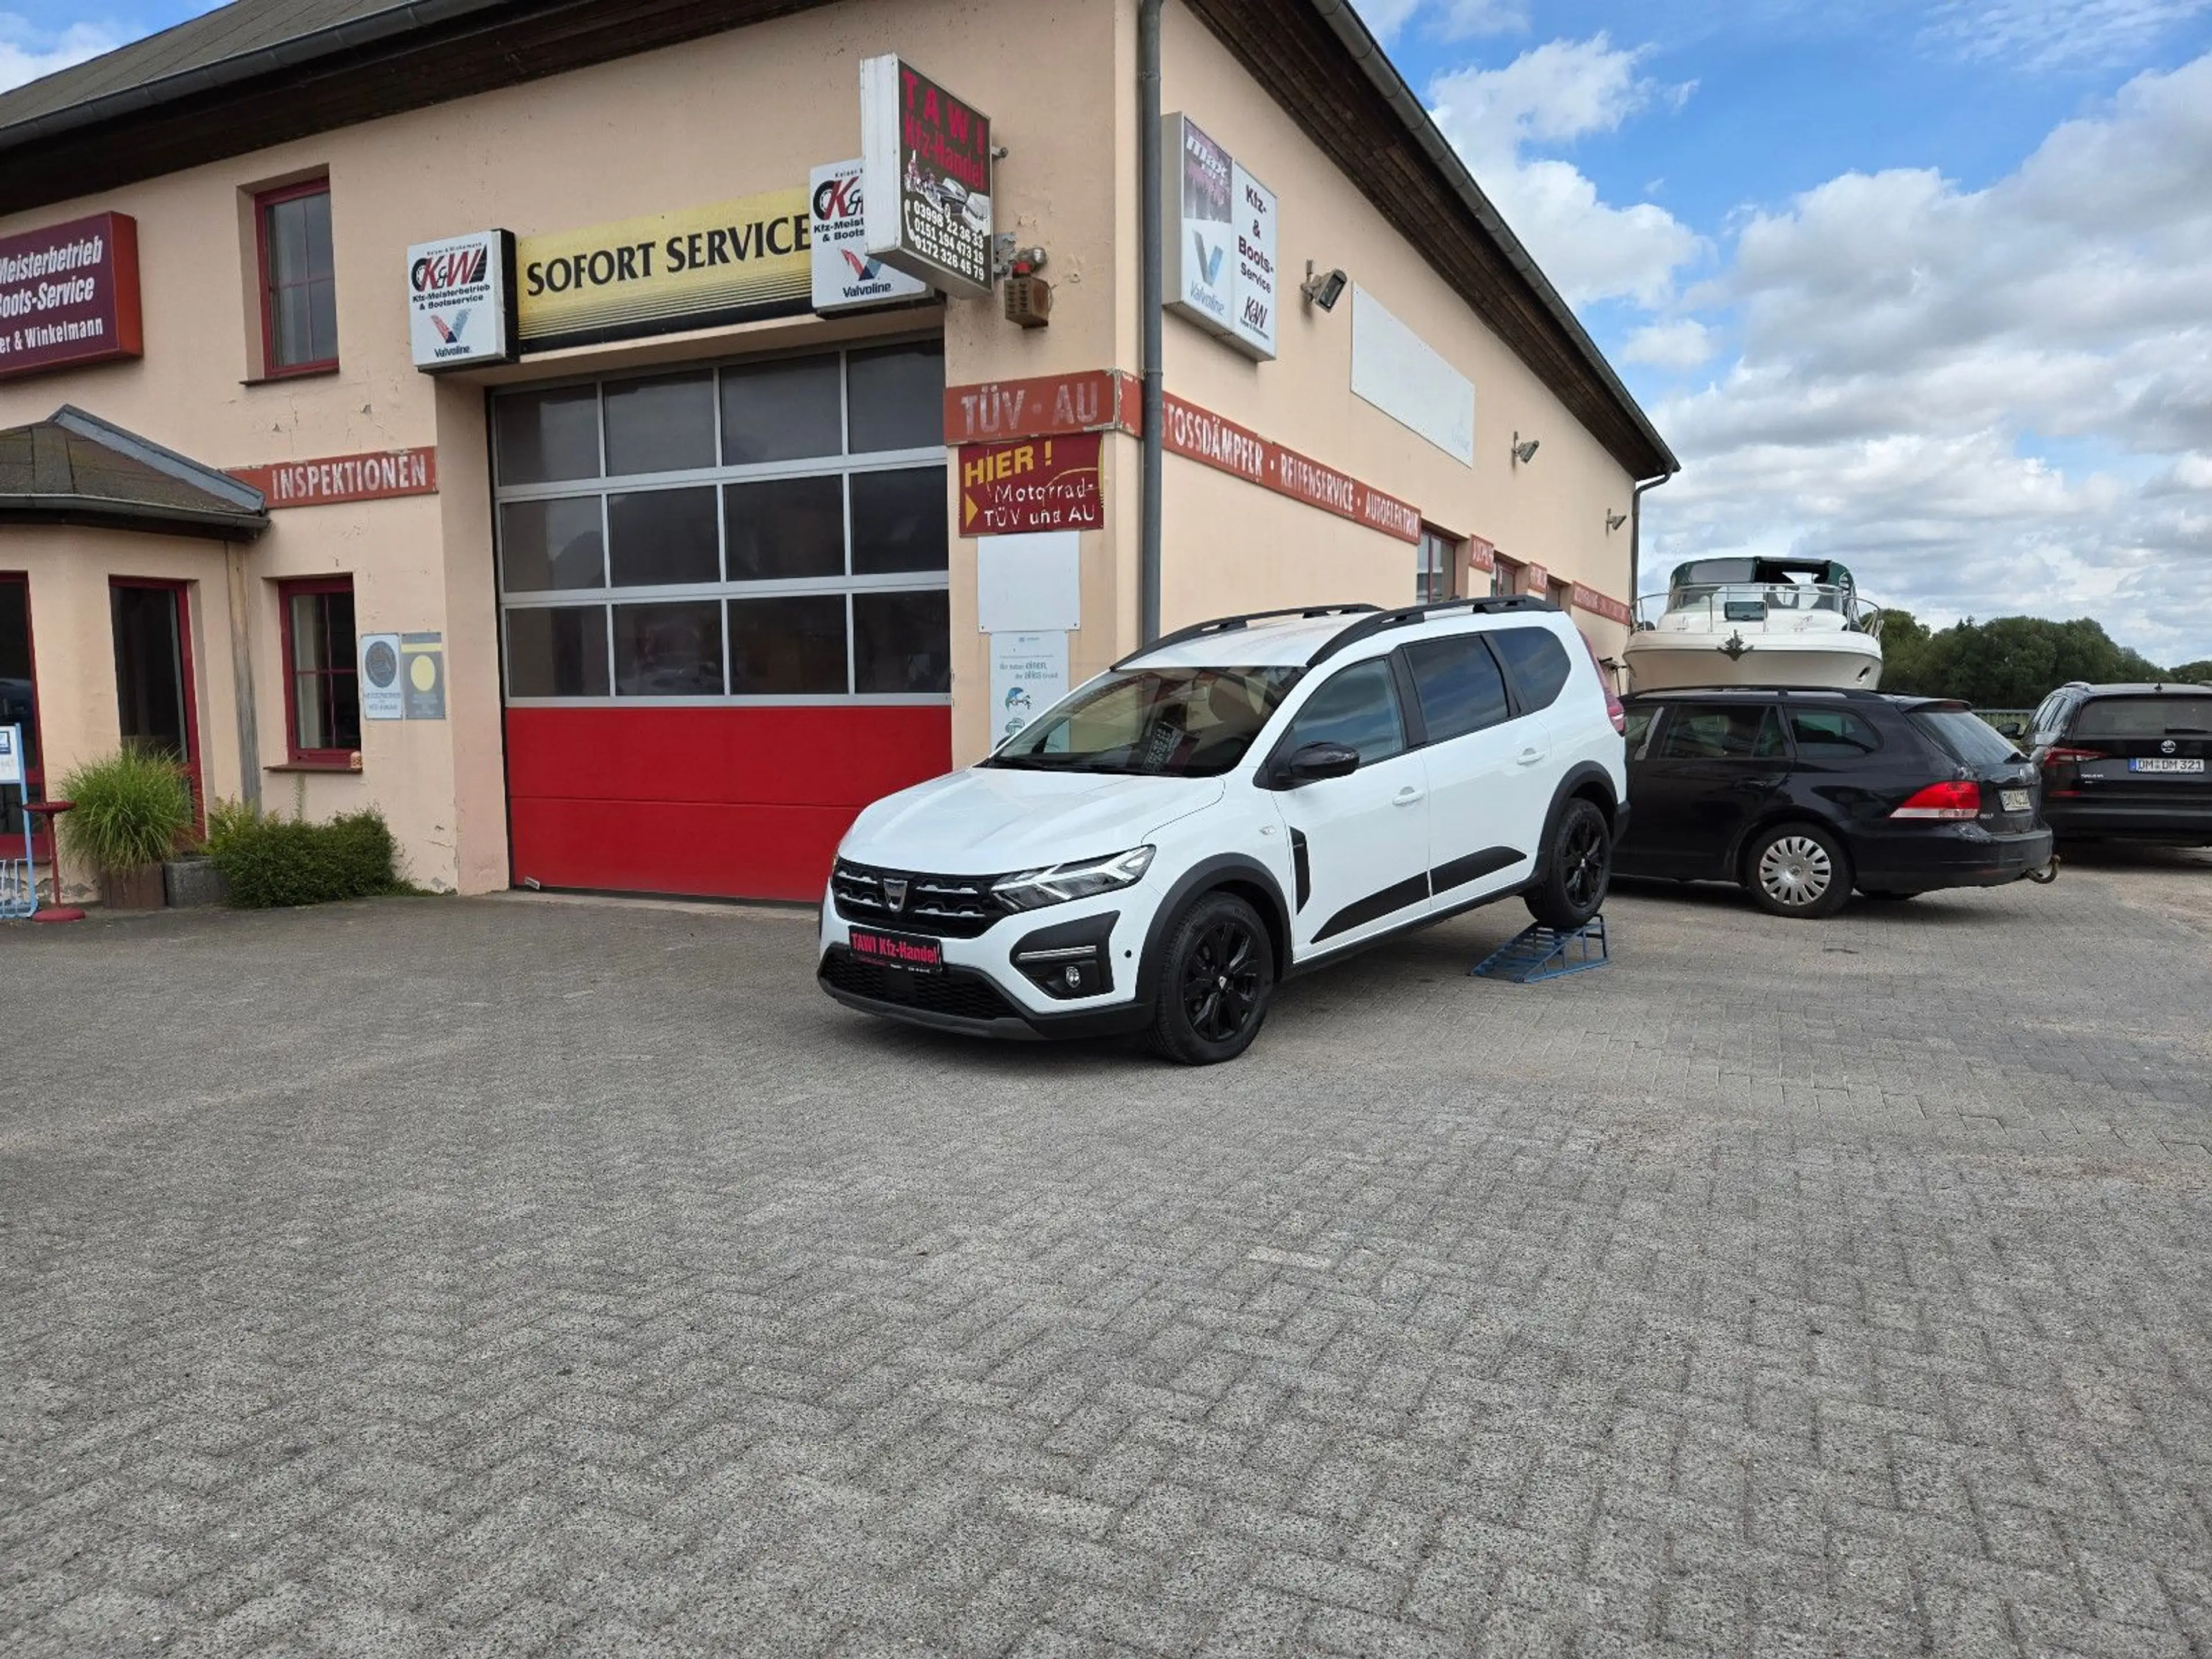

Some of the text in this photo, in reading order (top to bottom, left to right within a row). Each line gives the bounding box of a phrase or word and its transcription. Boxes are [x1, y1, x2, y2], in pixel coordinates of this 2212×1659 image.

[914, 200, 944, 228] 03998
[1252, 219, 1261, 240] &
[822, 233, 830, 242] &
[914, 217, 984, 265] 0151 194 473 19
[527, 213, 812, 297] SOFORT SERVICE
[915, 235, 939, 259] 0172
[960, 258, 971, 274] 45
[973, 264, 984, 281] 79
[412, 284, 490, 303] Kfz-Meisterbetrieb
[843, 282, 892, 298] Valvoline
[1240, 262, 1271, 294] Service
[419, 294, 483, 310] & Bootsservice
[1190, 279, 1225, 317] Valvoline
[14, 330, 23, 351] &
[25, 317, 103, 349] Winkelmann
[434, 346, 470, 358] Valvoline
[961, 381, 1098, 434] TÜV AU
[272, 454, 426, 500] INSPEKTIONEN
[965, 445, 1034, 487] HIER
[1281, 453, 1353, 512] REIFENSERVICE
[984, 503, 1095, 527] TÜV und AU
[2180, 760, 2202, 770] 321
[851, 933, 876, 953] TAWI
[878, 937, 938, 964] Kfz-Handel
